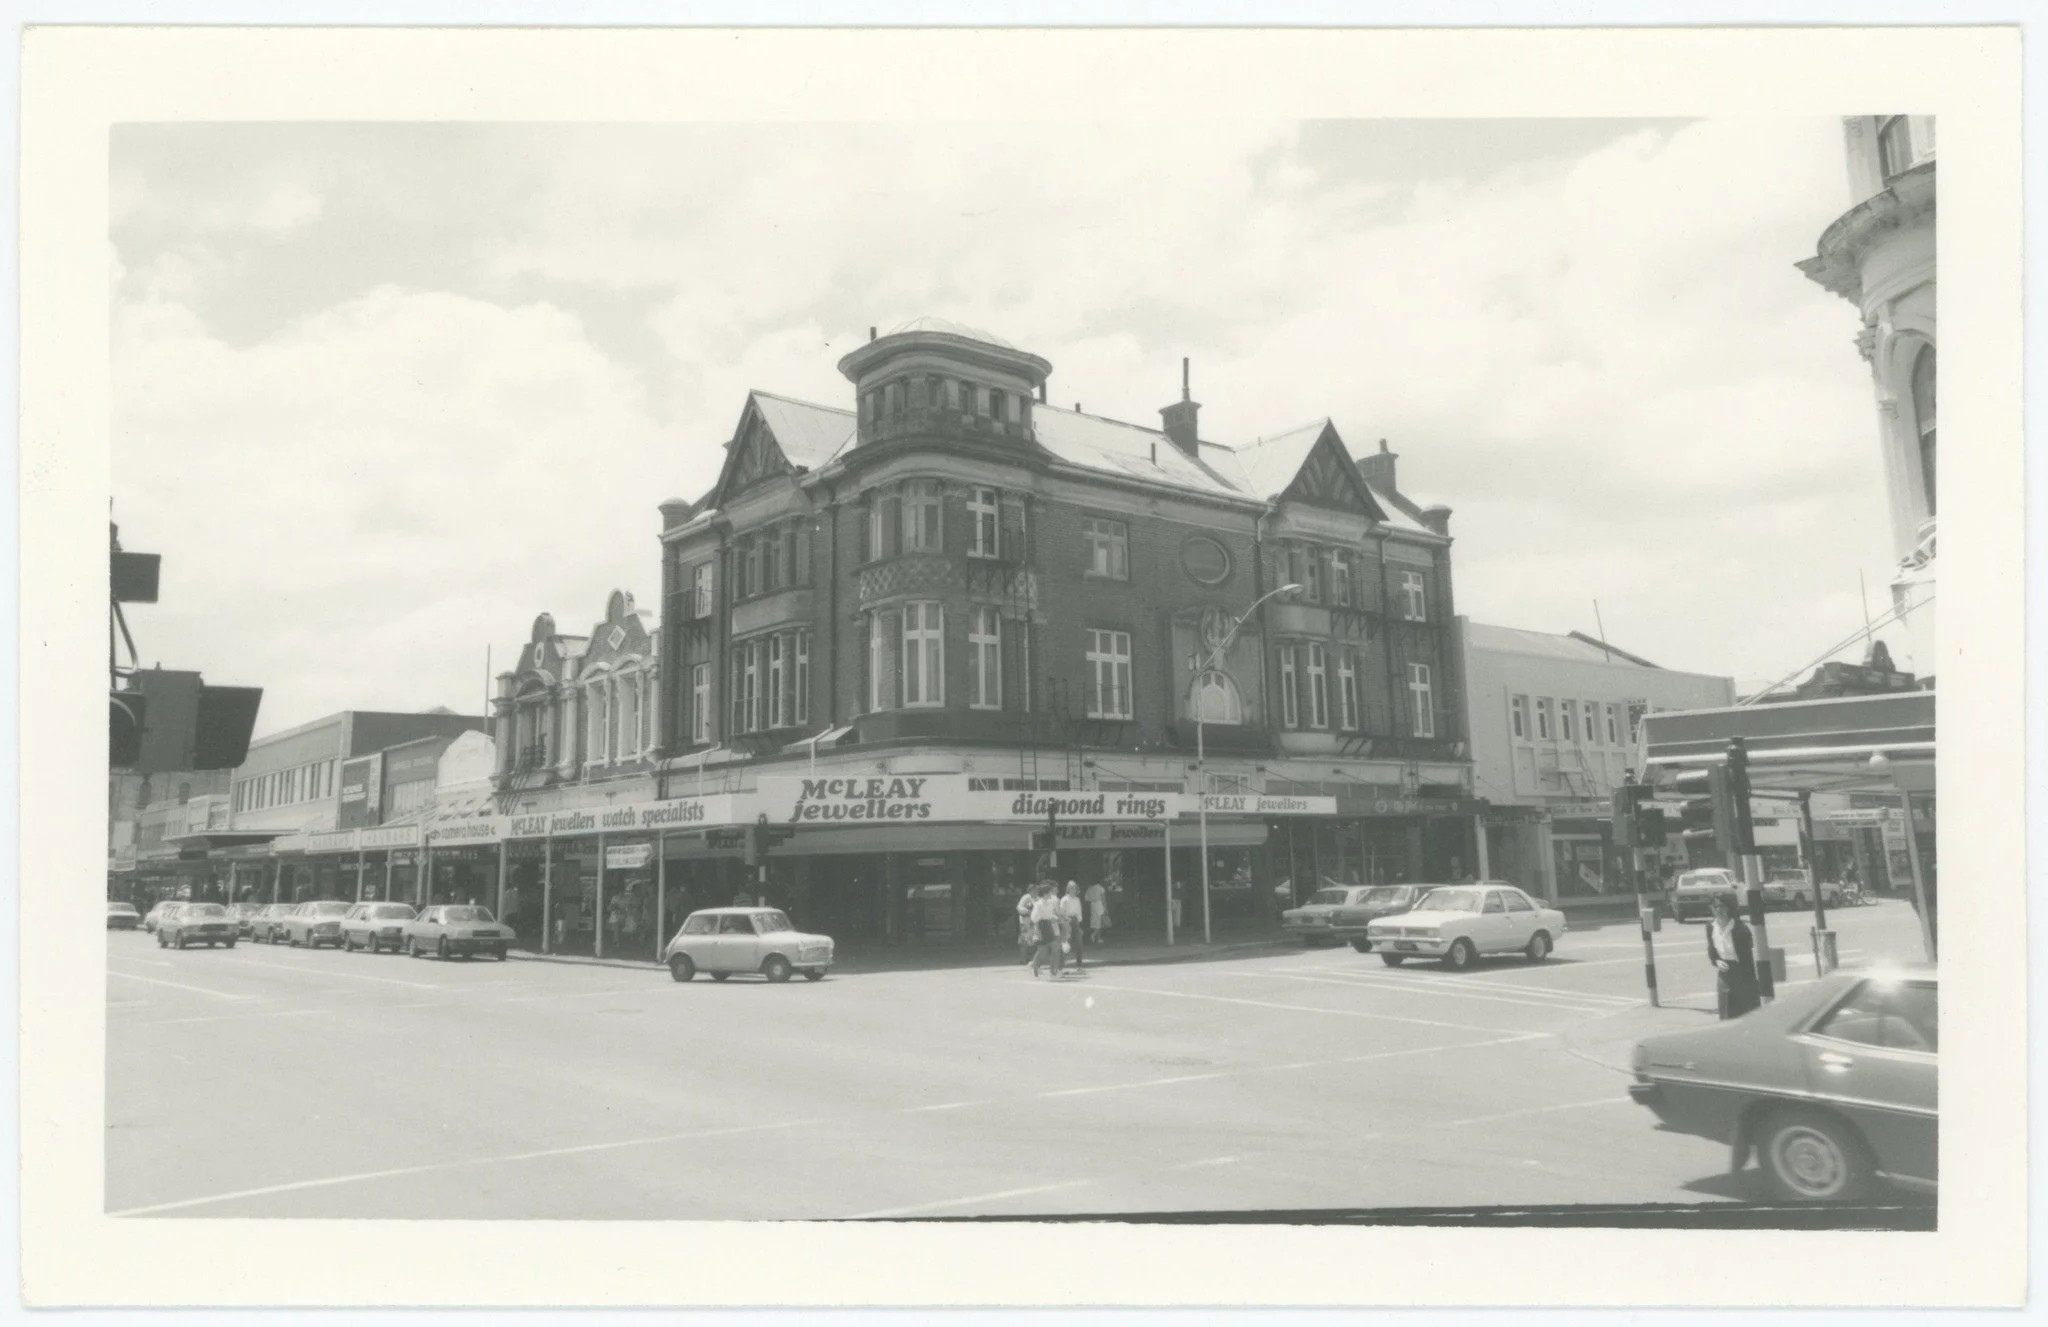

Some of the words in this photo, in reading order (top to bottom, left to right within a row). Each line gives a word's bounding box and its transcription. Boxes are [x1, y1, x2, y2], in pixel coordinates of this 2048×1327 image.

[801, 778, 927, 800] McLEAY
[790, 798, 932, 823] jewellers
[1012, 793, 1105, 815] diamond
[1117, 793, 1166, 818] rings
[1256, 796, 1308, 811] jewellers
[549, 811, 595, 836] jewellers
[602, 805, 636, 828] watch
[642, 800, 705, 828] specialists
[1055, 825, 1097, 839] cLEAY
